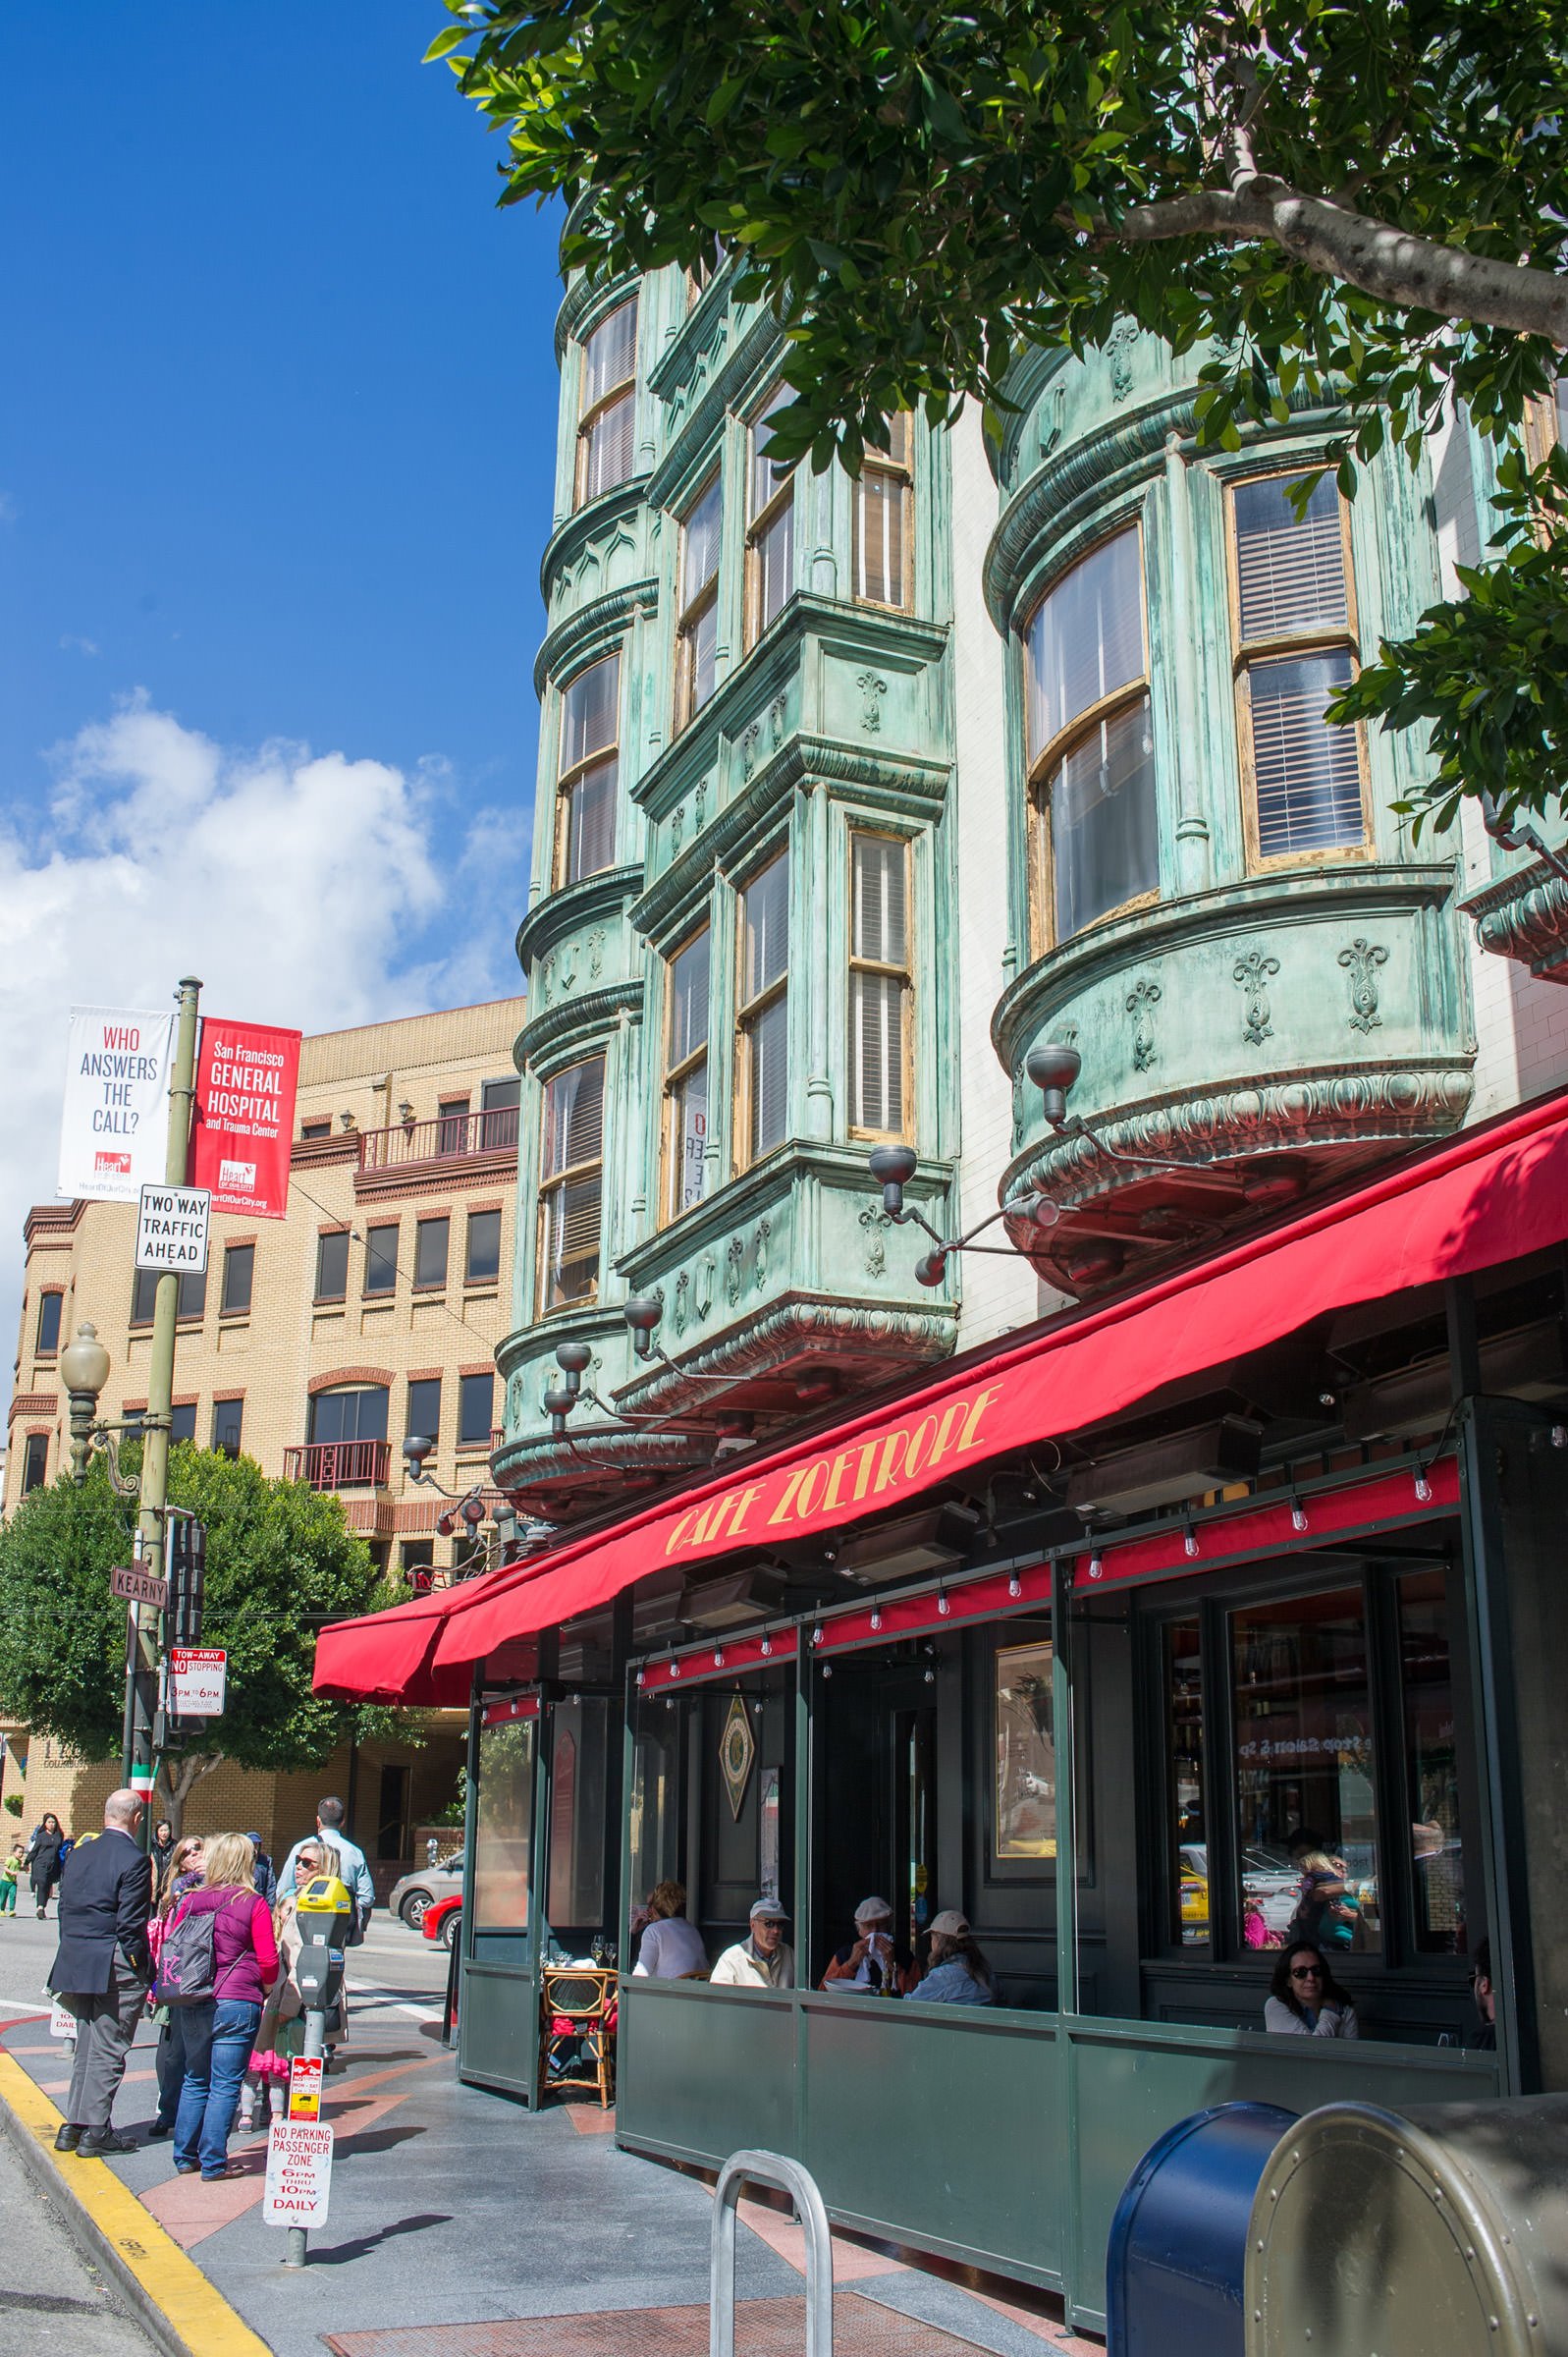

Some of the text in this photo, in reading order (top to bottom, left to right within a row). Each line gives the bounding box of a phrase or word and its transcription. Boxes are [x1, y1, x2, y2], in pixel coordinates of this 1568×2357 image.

[103, 1026, 139, 1052] WHO
[213, 1041, 285, 1068] San Francisco
[80, 1053, 158, 1080] ANSWERS
[210, 1062, 283, 1095] GENERAL
[103, 1082, 133, 1106] THE
[207, 1090, 280, 1123] HOSPITAL
[92, 1110, 139, 1134] CALL?
[205, 1118, 279, 1139] and Trauma Center
[96, 1157, 122, 1174] Heart
[222, 1166, 245, 1183] Heart
[143, 1195, 206, 1216] TWO WAY
[211, 1193, 268, 1210] artOfOurCity.org
[143, 1218, 203, 1238] TRAFFIC
[144, 1241, 197, 1261] AHEAD
[665, 1383, 1004, 1557] CAFE ZOETROPE
[117, 1572, 164, 1602] KEARNY
[171, 1660, 223, 1672] NO STOPPING
[177, 1651, 220, 1661] TOW-AWAY
[161, 1954, 182, 1987] K
[273, 2127, 331, 2141] NO PARKING
[272, 2140, 330, 2155] PASSENGER
[287, 2154, 313, 2166] ZONE
[282, 2168, 315, 2178] 6PM
[279, 2185, 317, 2196] 10PM
[273, 2199, 318, 2211] DAILY
